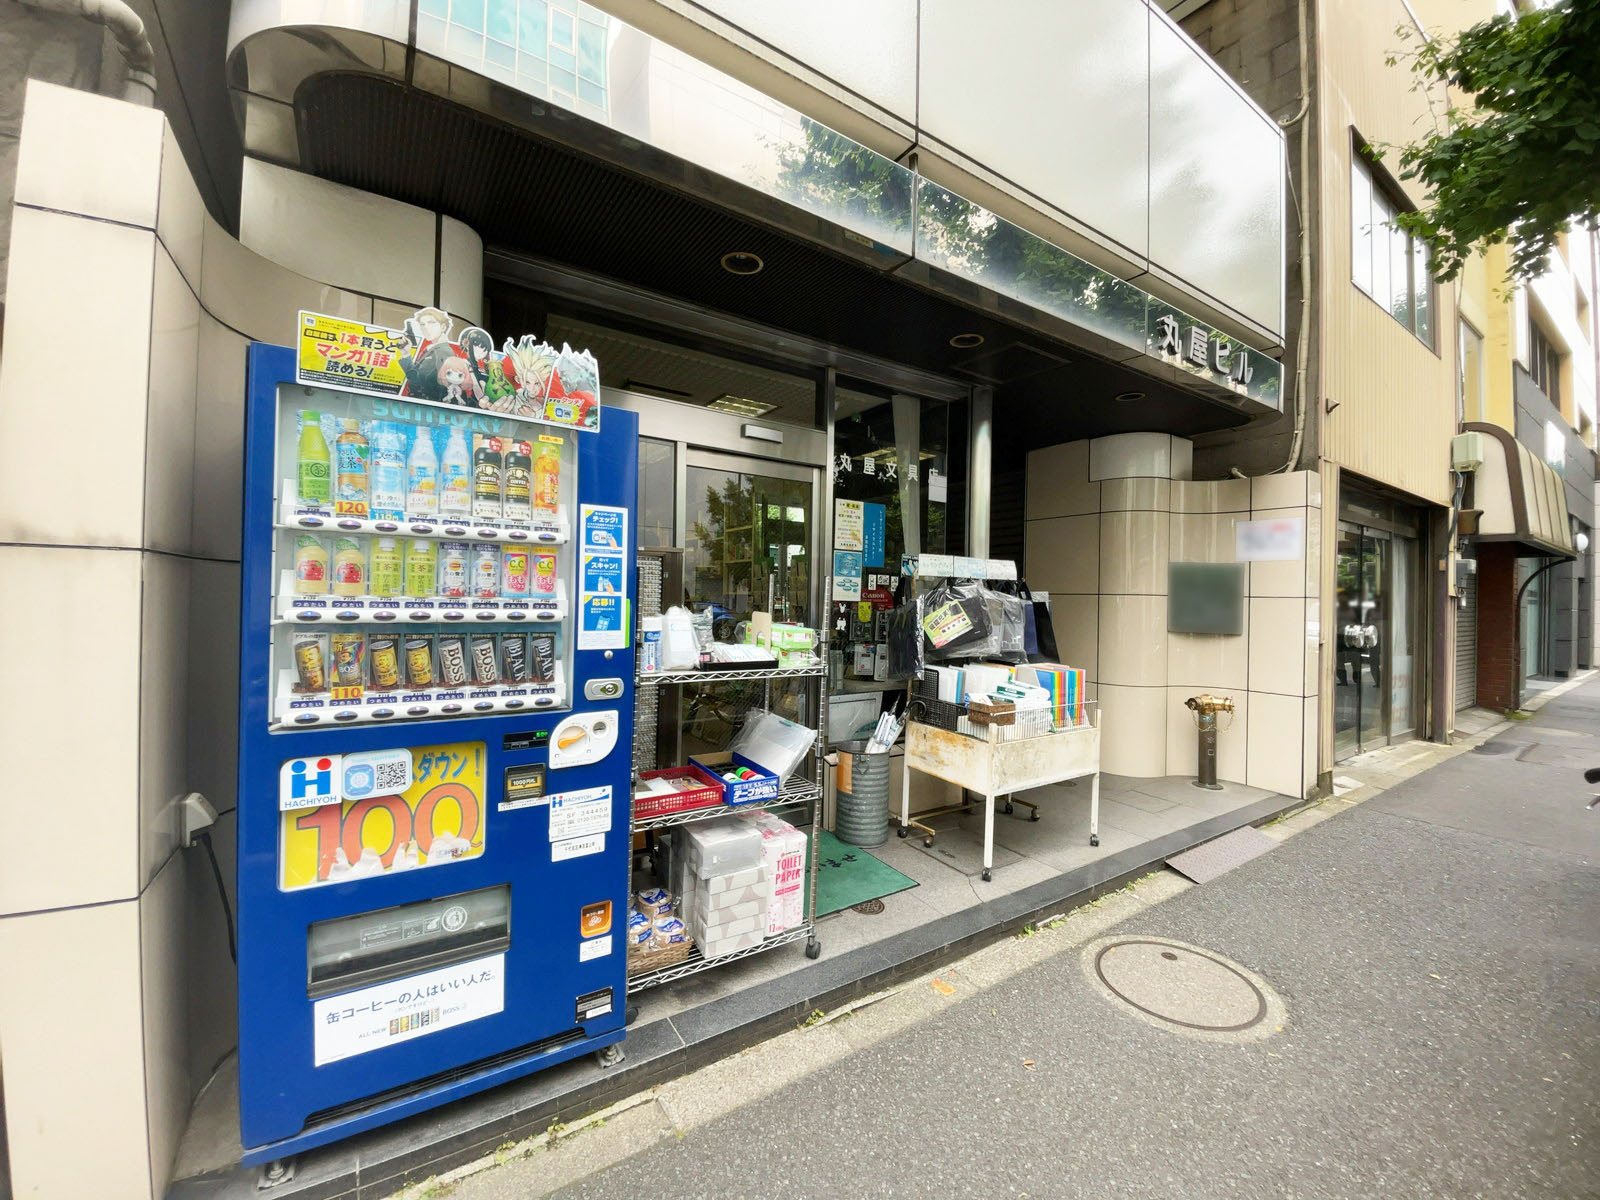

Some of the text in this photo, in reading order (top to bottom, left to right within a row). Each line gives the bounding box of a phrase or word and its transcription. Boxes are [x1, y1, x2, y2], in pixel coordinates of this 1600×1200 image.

[317, 342, 391, 368] マンガ1話
[1156, 314, 1253, 384] 丸屋ビル
[336, 501, 366, 514] 120
[507, 641, 525, 681] BLACK
[538, 641, 553, 680] BLACK
[332, 688, 360, 699] 110
[412, 748, 481, 783] ダウン!
[284, 796, 337, 809] HACHIYOH
[296, 782, 482, 882] 100
[775, 855, 802, 872] TOILET
[775, 868, 801, 885] PAPER
